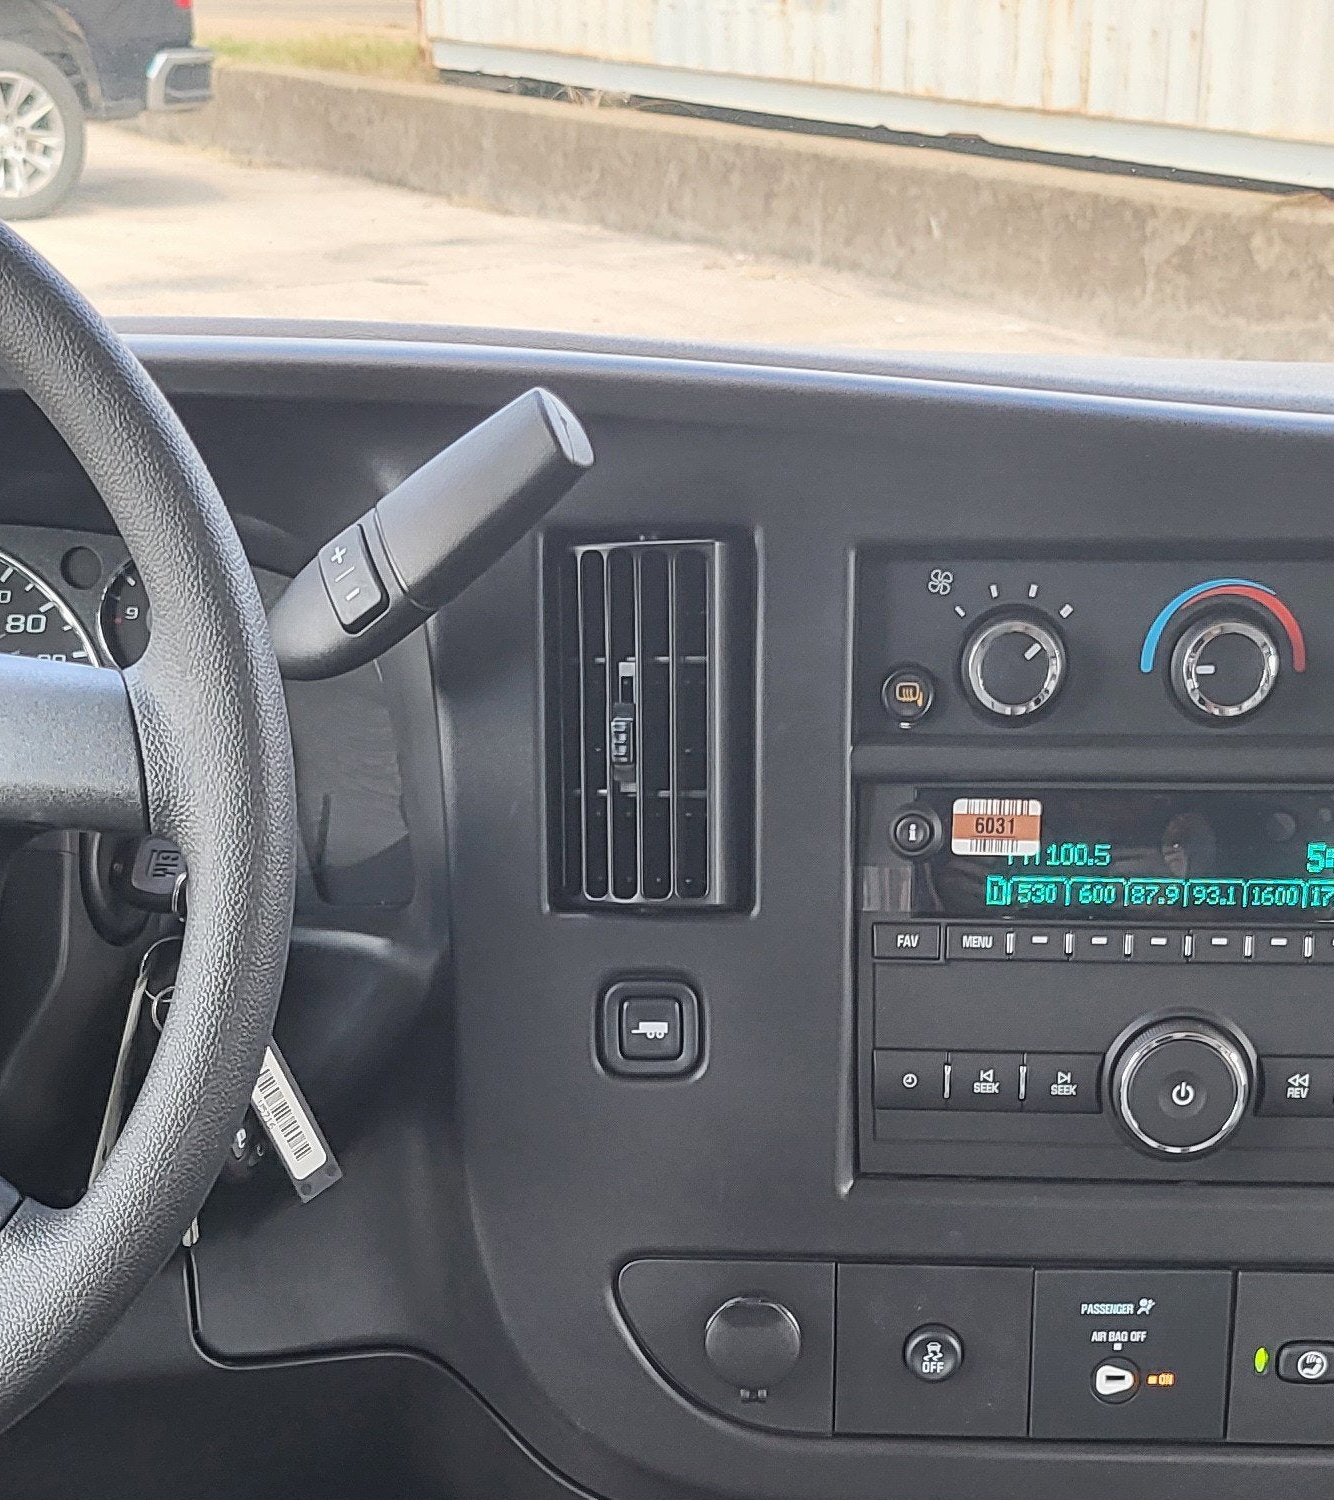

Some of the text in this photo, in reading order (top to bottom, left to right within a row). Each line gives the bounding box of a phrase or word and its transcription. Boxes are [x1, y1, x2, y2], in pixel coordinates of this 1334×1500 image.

[5, 614, 47, 633] 80
[975, 817, 1015, 835] 6031
[1045, 843, 1112, 867] 100.5
[1017, 884, 1058, 905] 530
[1078, 884, 1116, 905] 600
[1131, 885, 1180, 906] 87.9
[1192, 885, 1237, 906] 93.1
[1251, 886, 1299, 907] 1600
[897, 934, 919, 948] FAV
[962, 935, 993, 948] MENU
[973, 1082, 1000, 1094] SEEK
[1050, 1084, 1077, 1096] SEEK
[1286, 1087, 1309, 1099] REV
[1080, 1303, 1134, 1315] PASSENGER
[1091, 1331, 1147, 1342] AIR BAG OFF
[922, 1361, 944, 1373] OFF
